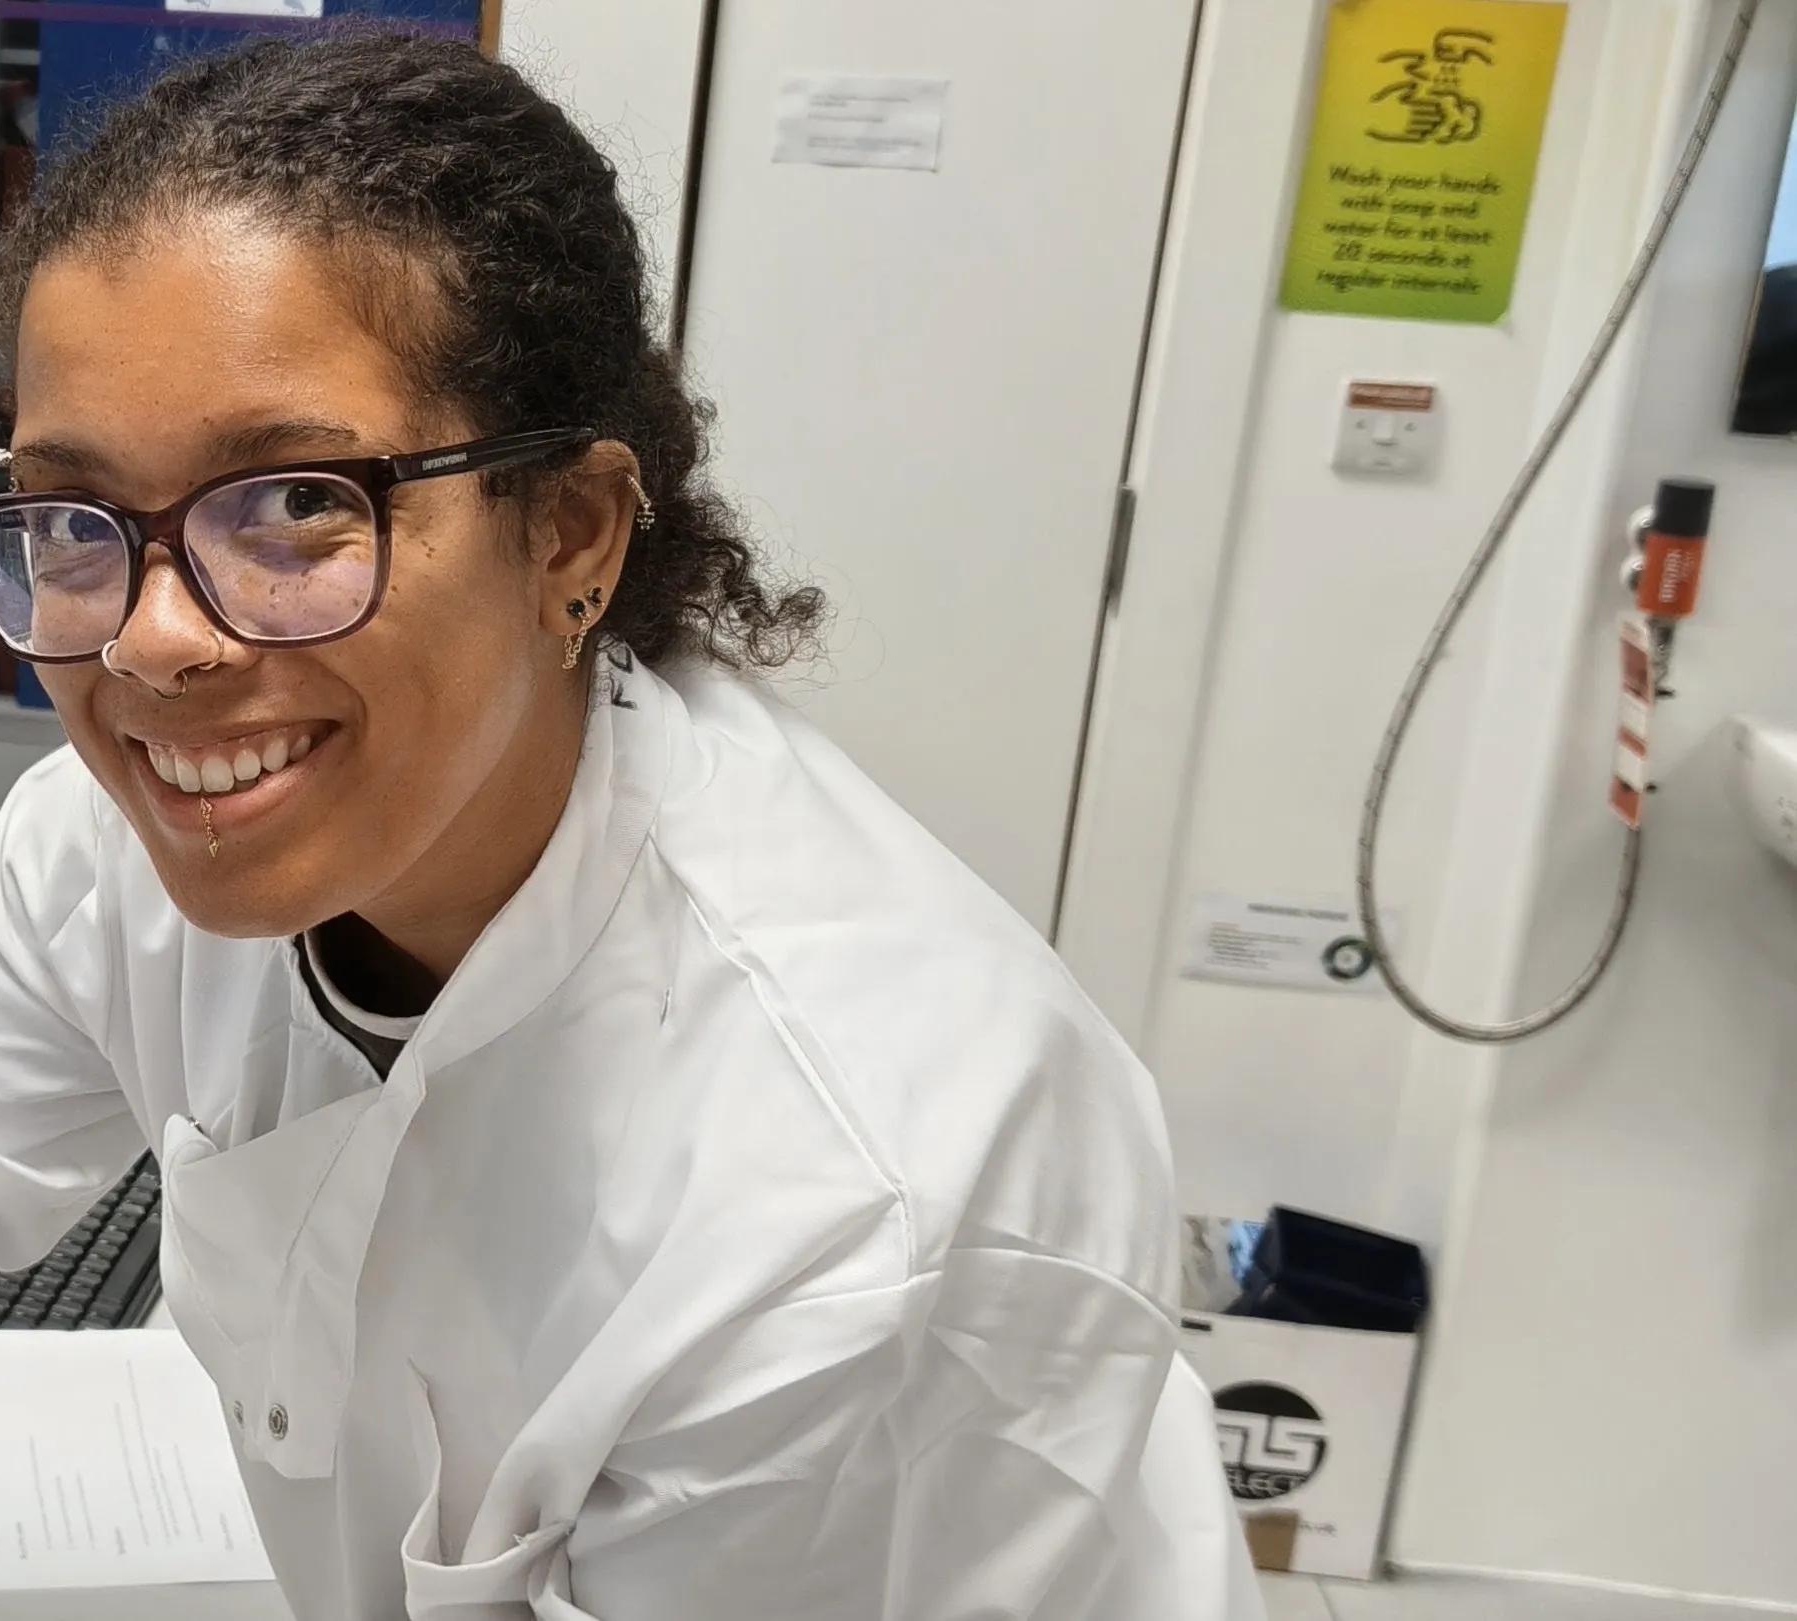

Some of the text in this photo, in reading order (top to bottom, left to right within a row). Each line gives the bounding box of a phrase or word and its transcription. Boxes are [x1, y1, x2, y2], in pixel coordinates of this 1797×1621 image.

[1330, 164, 1501, 195] Wash your hands
[1341, 195, 1479, 218] with soap and
[1324, 218, 1493, 245] water for at least
[1334, 241, 1472, 268] 20 seconds at
[1317, 268, 1482, 294] regular intervals
